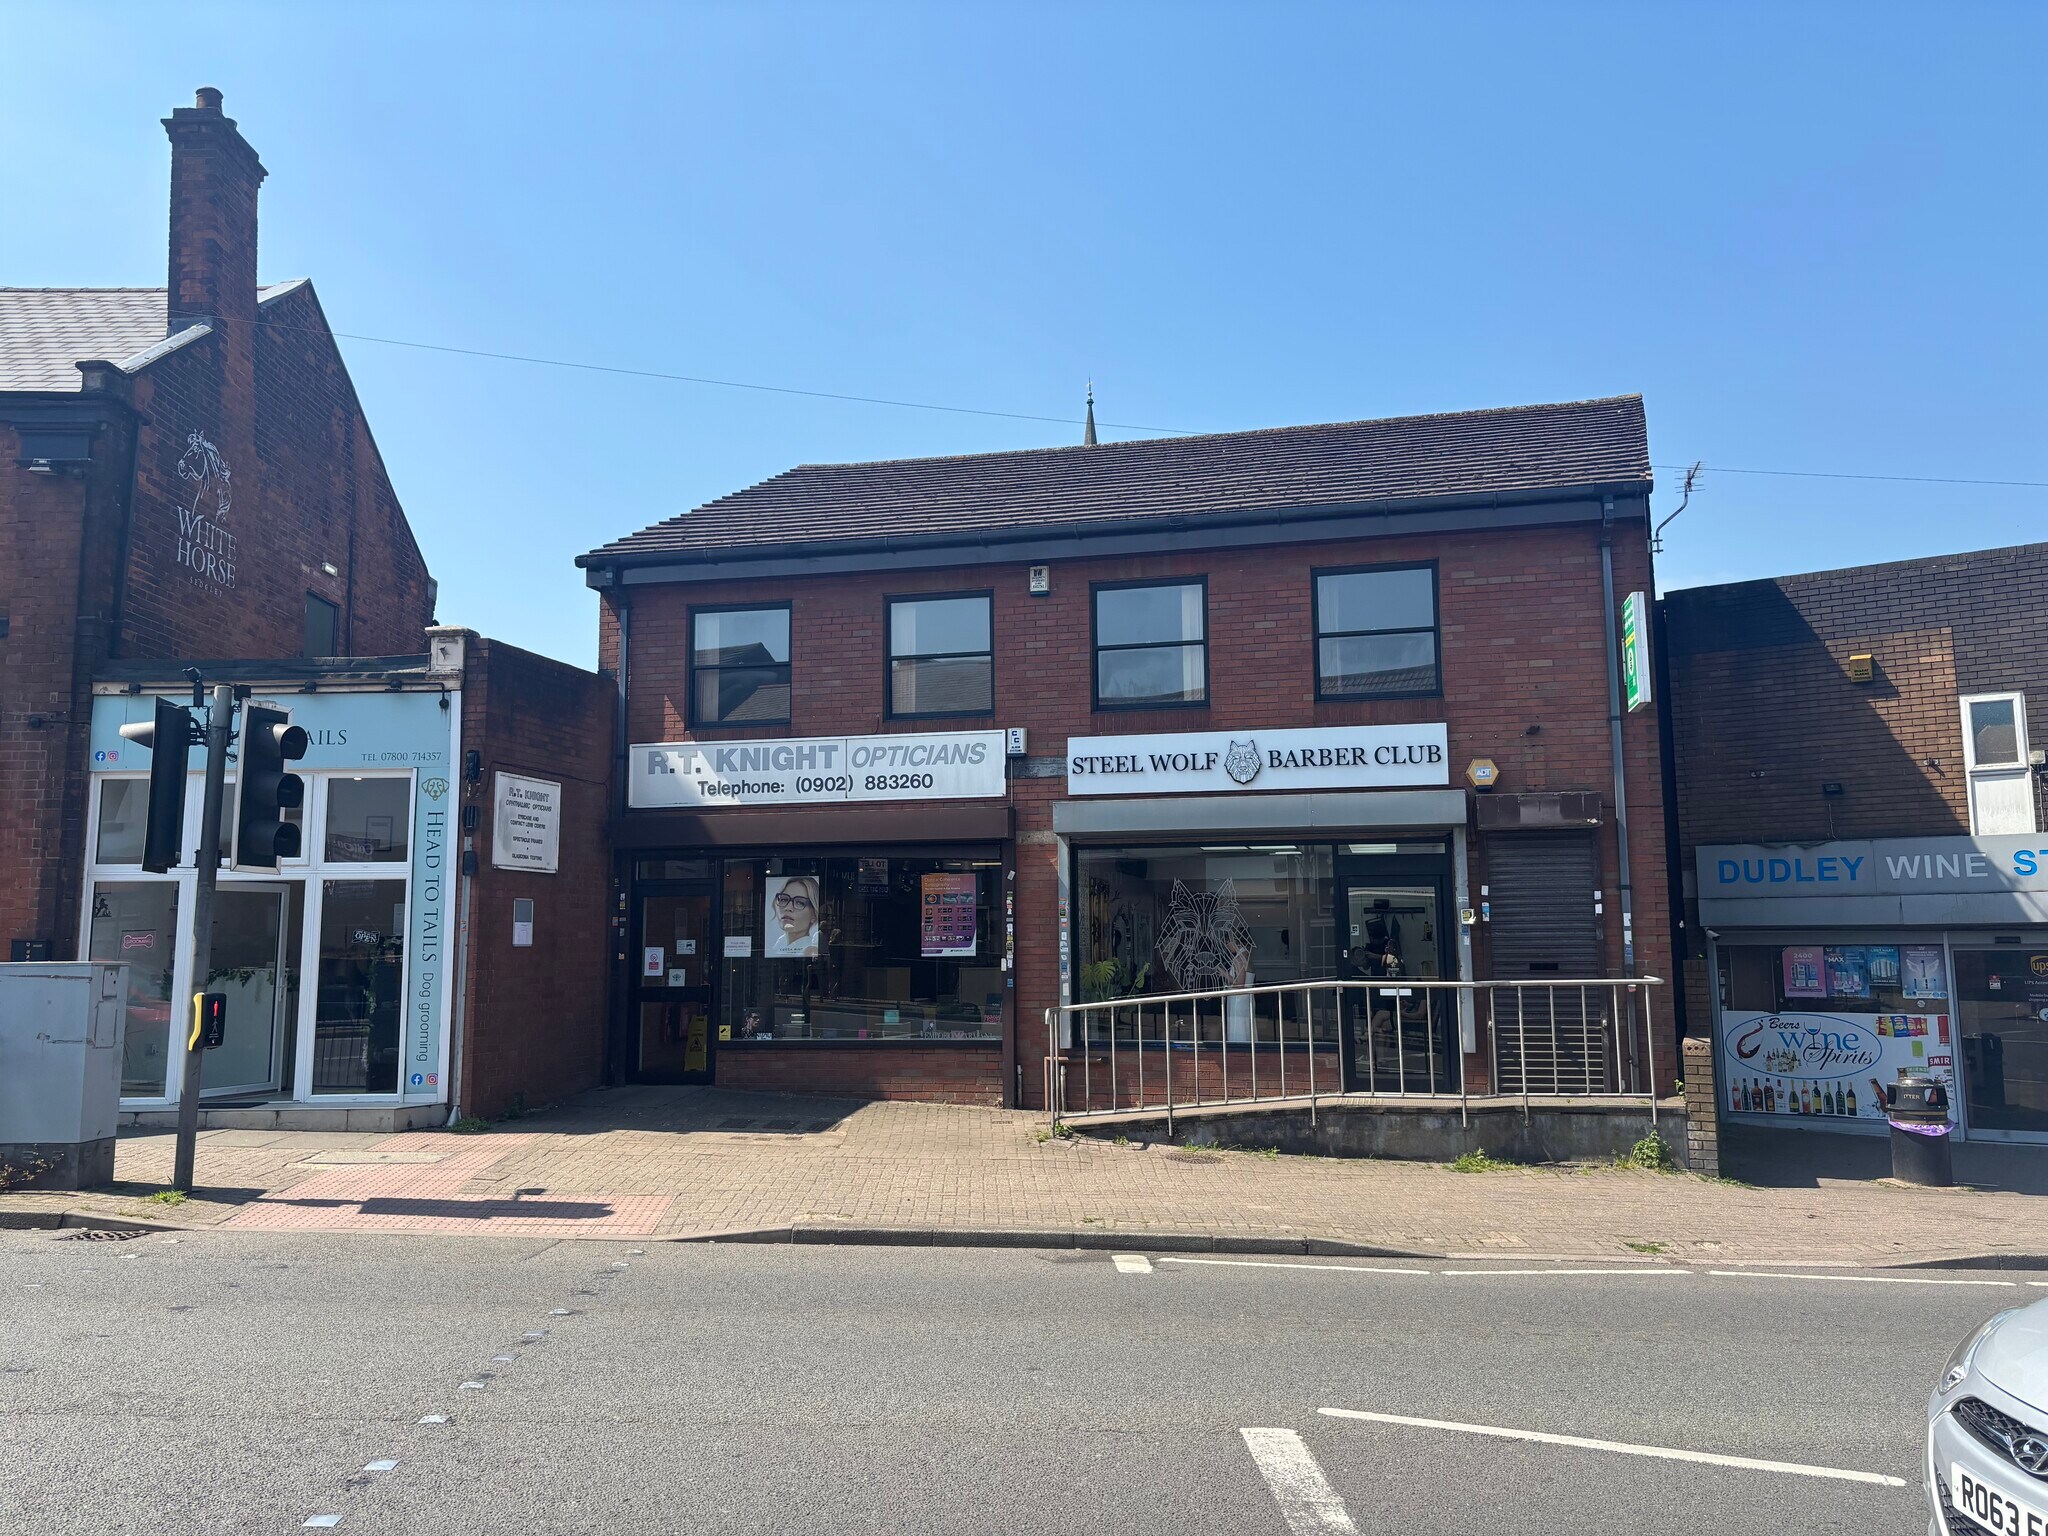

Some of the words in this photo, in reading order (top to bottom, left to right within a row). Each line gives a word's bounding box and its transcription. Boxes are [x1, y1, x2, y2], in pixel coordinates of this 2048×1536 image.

[177, 506, 237, 560] WHITE
[176, 538, 235, 588] HORSE
[306, 729, 347, 746] AILS
[361, 753, 378, 762] TEL
[381, 752, 408, 762] 07800
[412, 752, 442, 761] 714357
[647, 749, 701, 775] R.T.
[715, 744, 839, 773] KNIGHT
[851, 742, 987, 769] OPTICIANS
[1071, 754, 1144, 775] STEEL
[1149, 751, 1218, 773] WOLF
[1267, 746, 1368, 769] BARBER
[1373, 744, 1443, 766] CLUB
[1475, 767, 1492, 777] ADT
[508, 786, 523, 798] R.T.
[525, 789, 550, 802] KNIGHT
[697, 779, 785, 798] Telephone:
[795, 774, 854, 794] (0902)
[864, 773, 934, 791] 883260
[532, 803, 552, 812] OPTICIANS
[426, 811, 444, 869] HEAD
[1718, 855, 1865, 884] DUDLEY
[1885, 850, 1989, 880] WINE
[424, 875, 440, 901] TO
[354, 931, 378, 943] OPEN
[422, 908, 439, 962] TAILS
[419, 972, 434, 998] Dog
[416, 1002, 431, 1062] grooming
[1768, 1017, 1800, 1030] Beers
[1802, 1040, 1873, 1071] Spirits
[1929, 1057, 1951, 1065] SMIR
[1961, 1473, 2020, 1536] RO63
